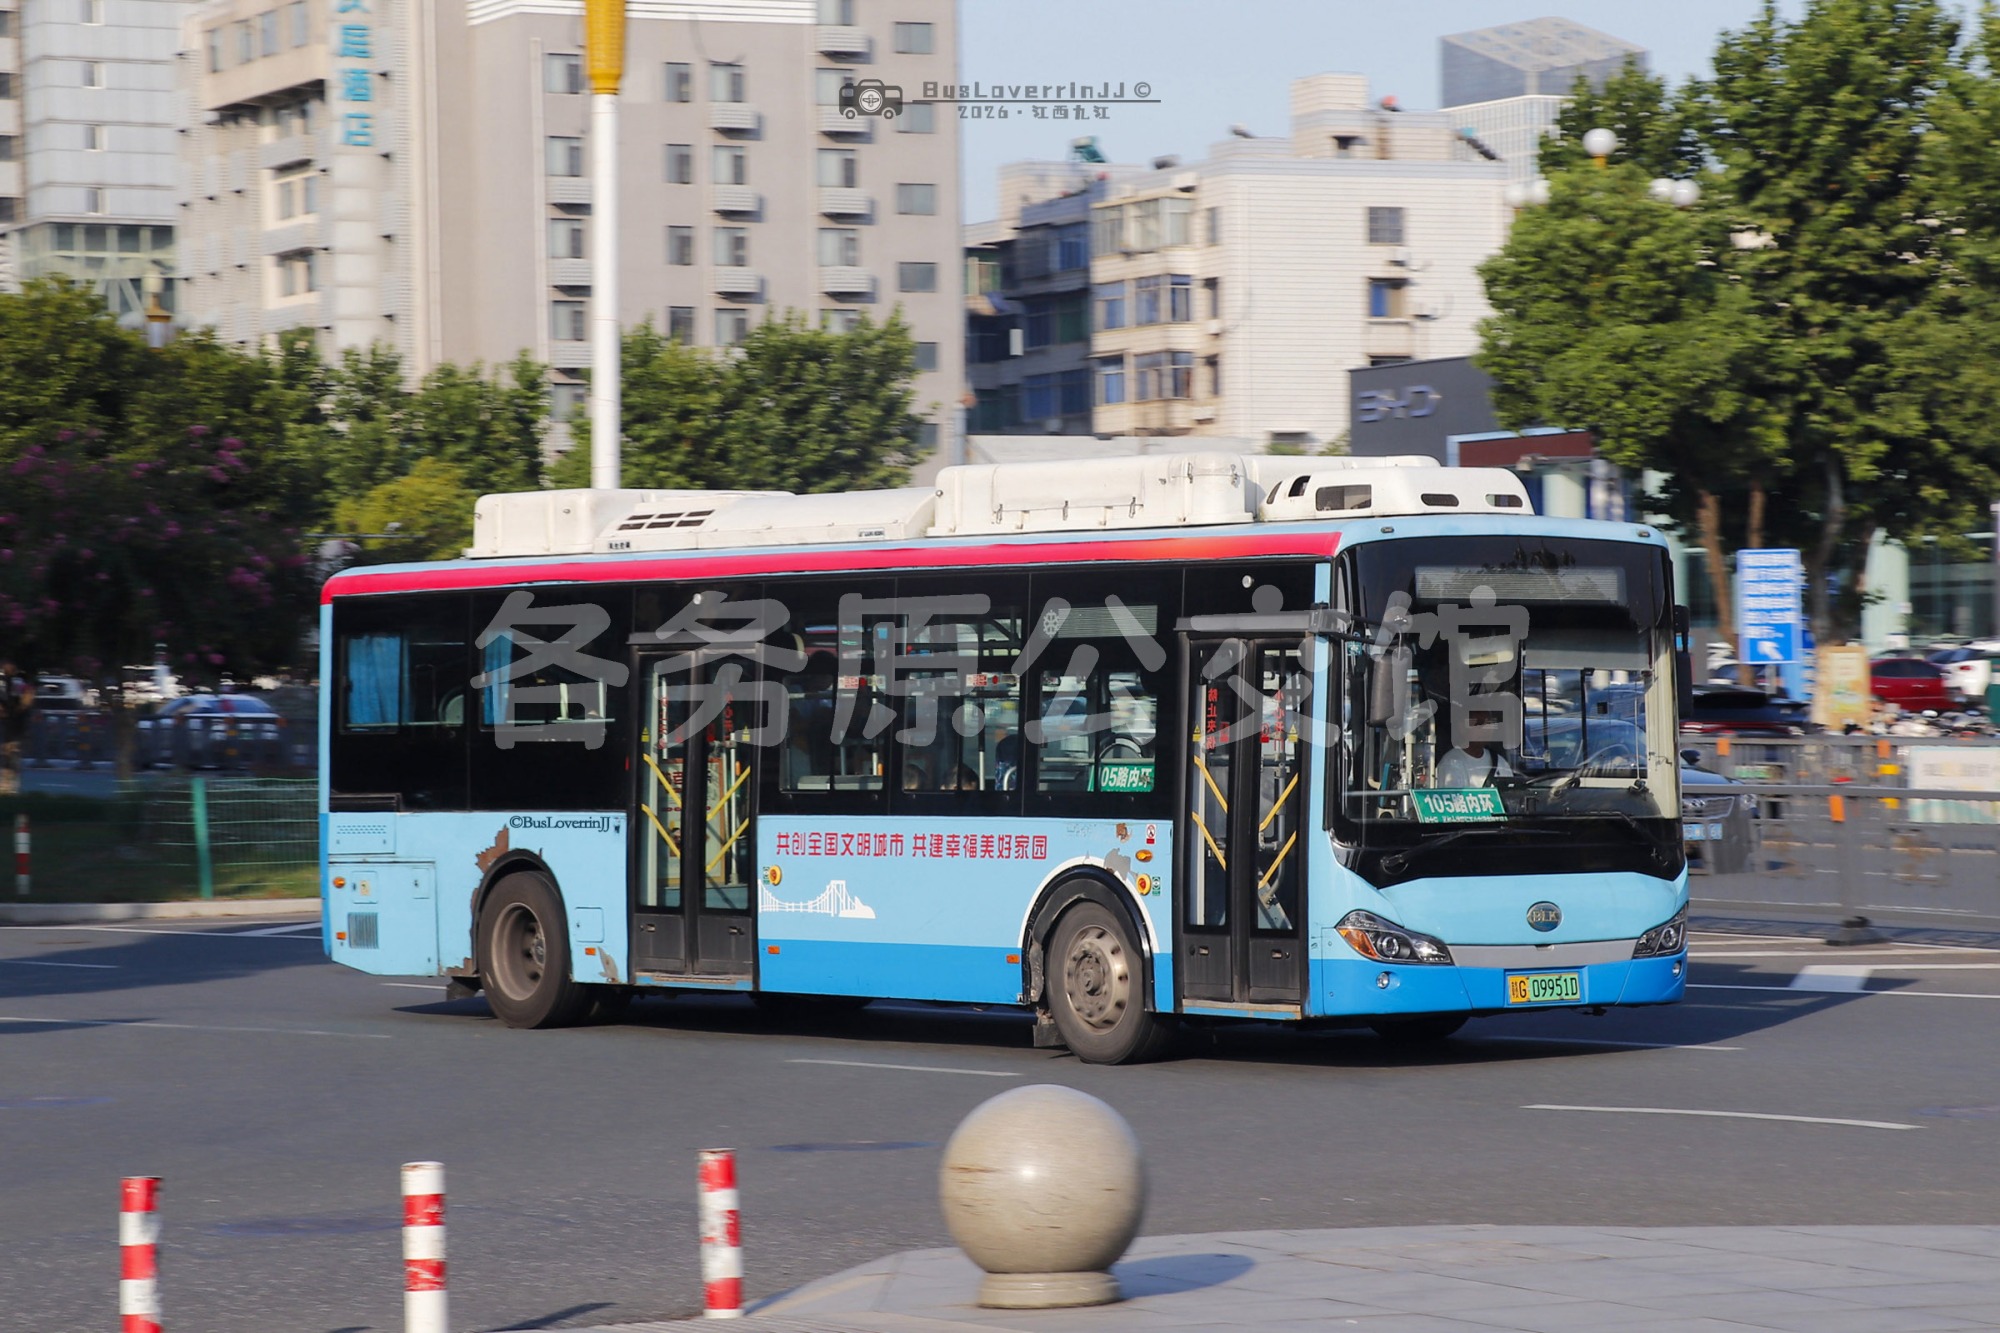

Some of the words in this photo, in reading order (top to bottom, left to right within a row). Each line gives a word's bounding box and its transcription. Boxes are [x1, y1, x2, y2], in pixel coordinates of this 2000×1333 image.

[1357, 384, 1437, 423] BYD
[1101, 767, 1152, 788] 05路内环
[1424, 793, 1494, 814] 105路内环
[777, 832, 904, 857] 共创全国文明城市
[912, 833, 1047, 860] 共建幸福美好家园
